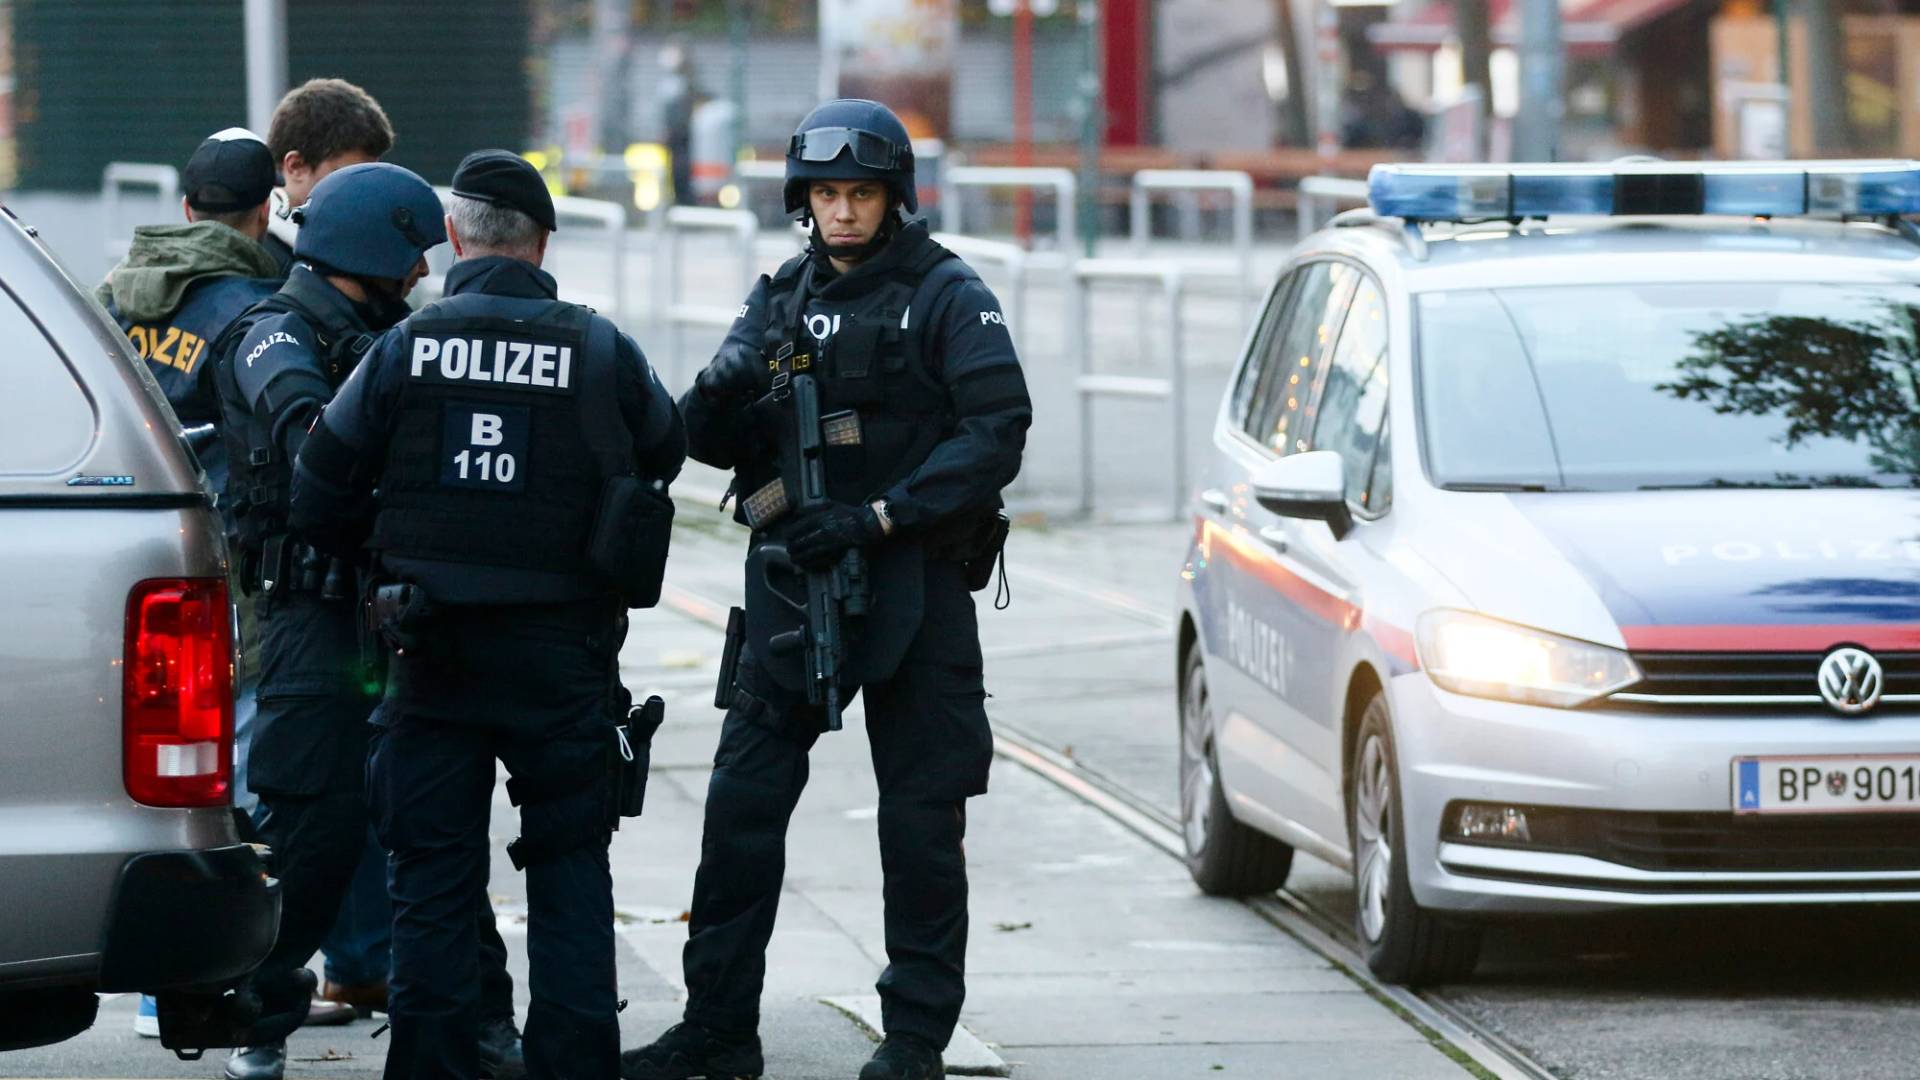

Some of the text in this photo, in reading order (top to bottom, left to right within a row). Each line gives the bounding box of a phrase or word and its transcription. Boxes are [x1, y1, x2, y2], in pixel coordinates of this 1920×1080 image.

[411, 337, 572, 388] POLIZEI
[768, 353, 811, 372] PIZEI
[470, 412, 504, 447] B
[453, 449, 516, 483] 110
[1227, 600, 1286, 697] POLIZEI
[1778, 766, 1821, 802] BP
[1853, 765, 1920, 802] 901
